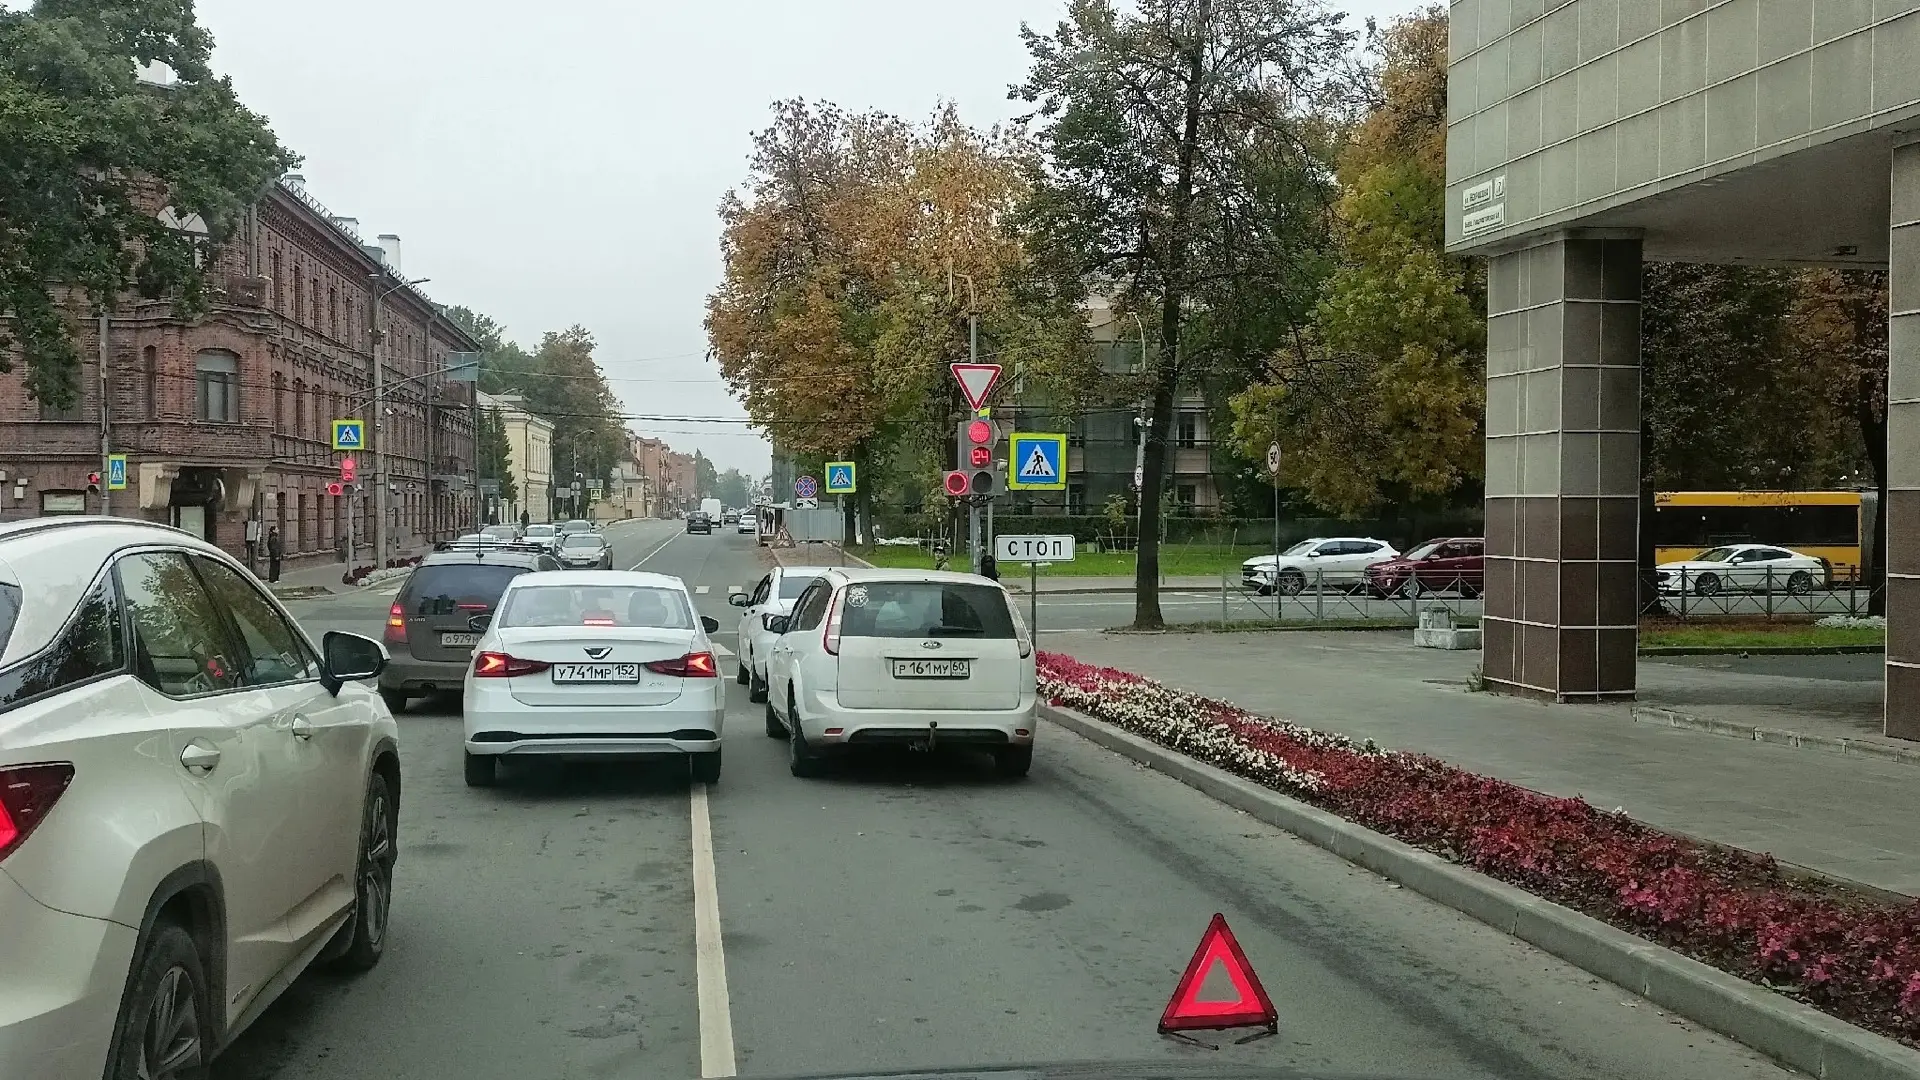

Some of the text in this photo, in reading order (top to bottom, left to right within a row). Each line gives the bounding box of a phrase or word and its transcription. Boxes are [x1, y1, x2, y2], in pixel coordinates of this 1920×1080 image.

[1008, 540, 1062, 556] СТОП
[446, 634, 481, 644] О979М
[615, 664, 635, 676] 152
[953, 662, 965, 672] 60
